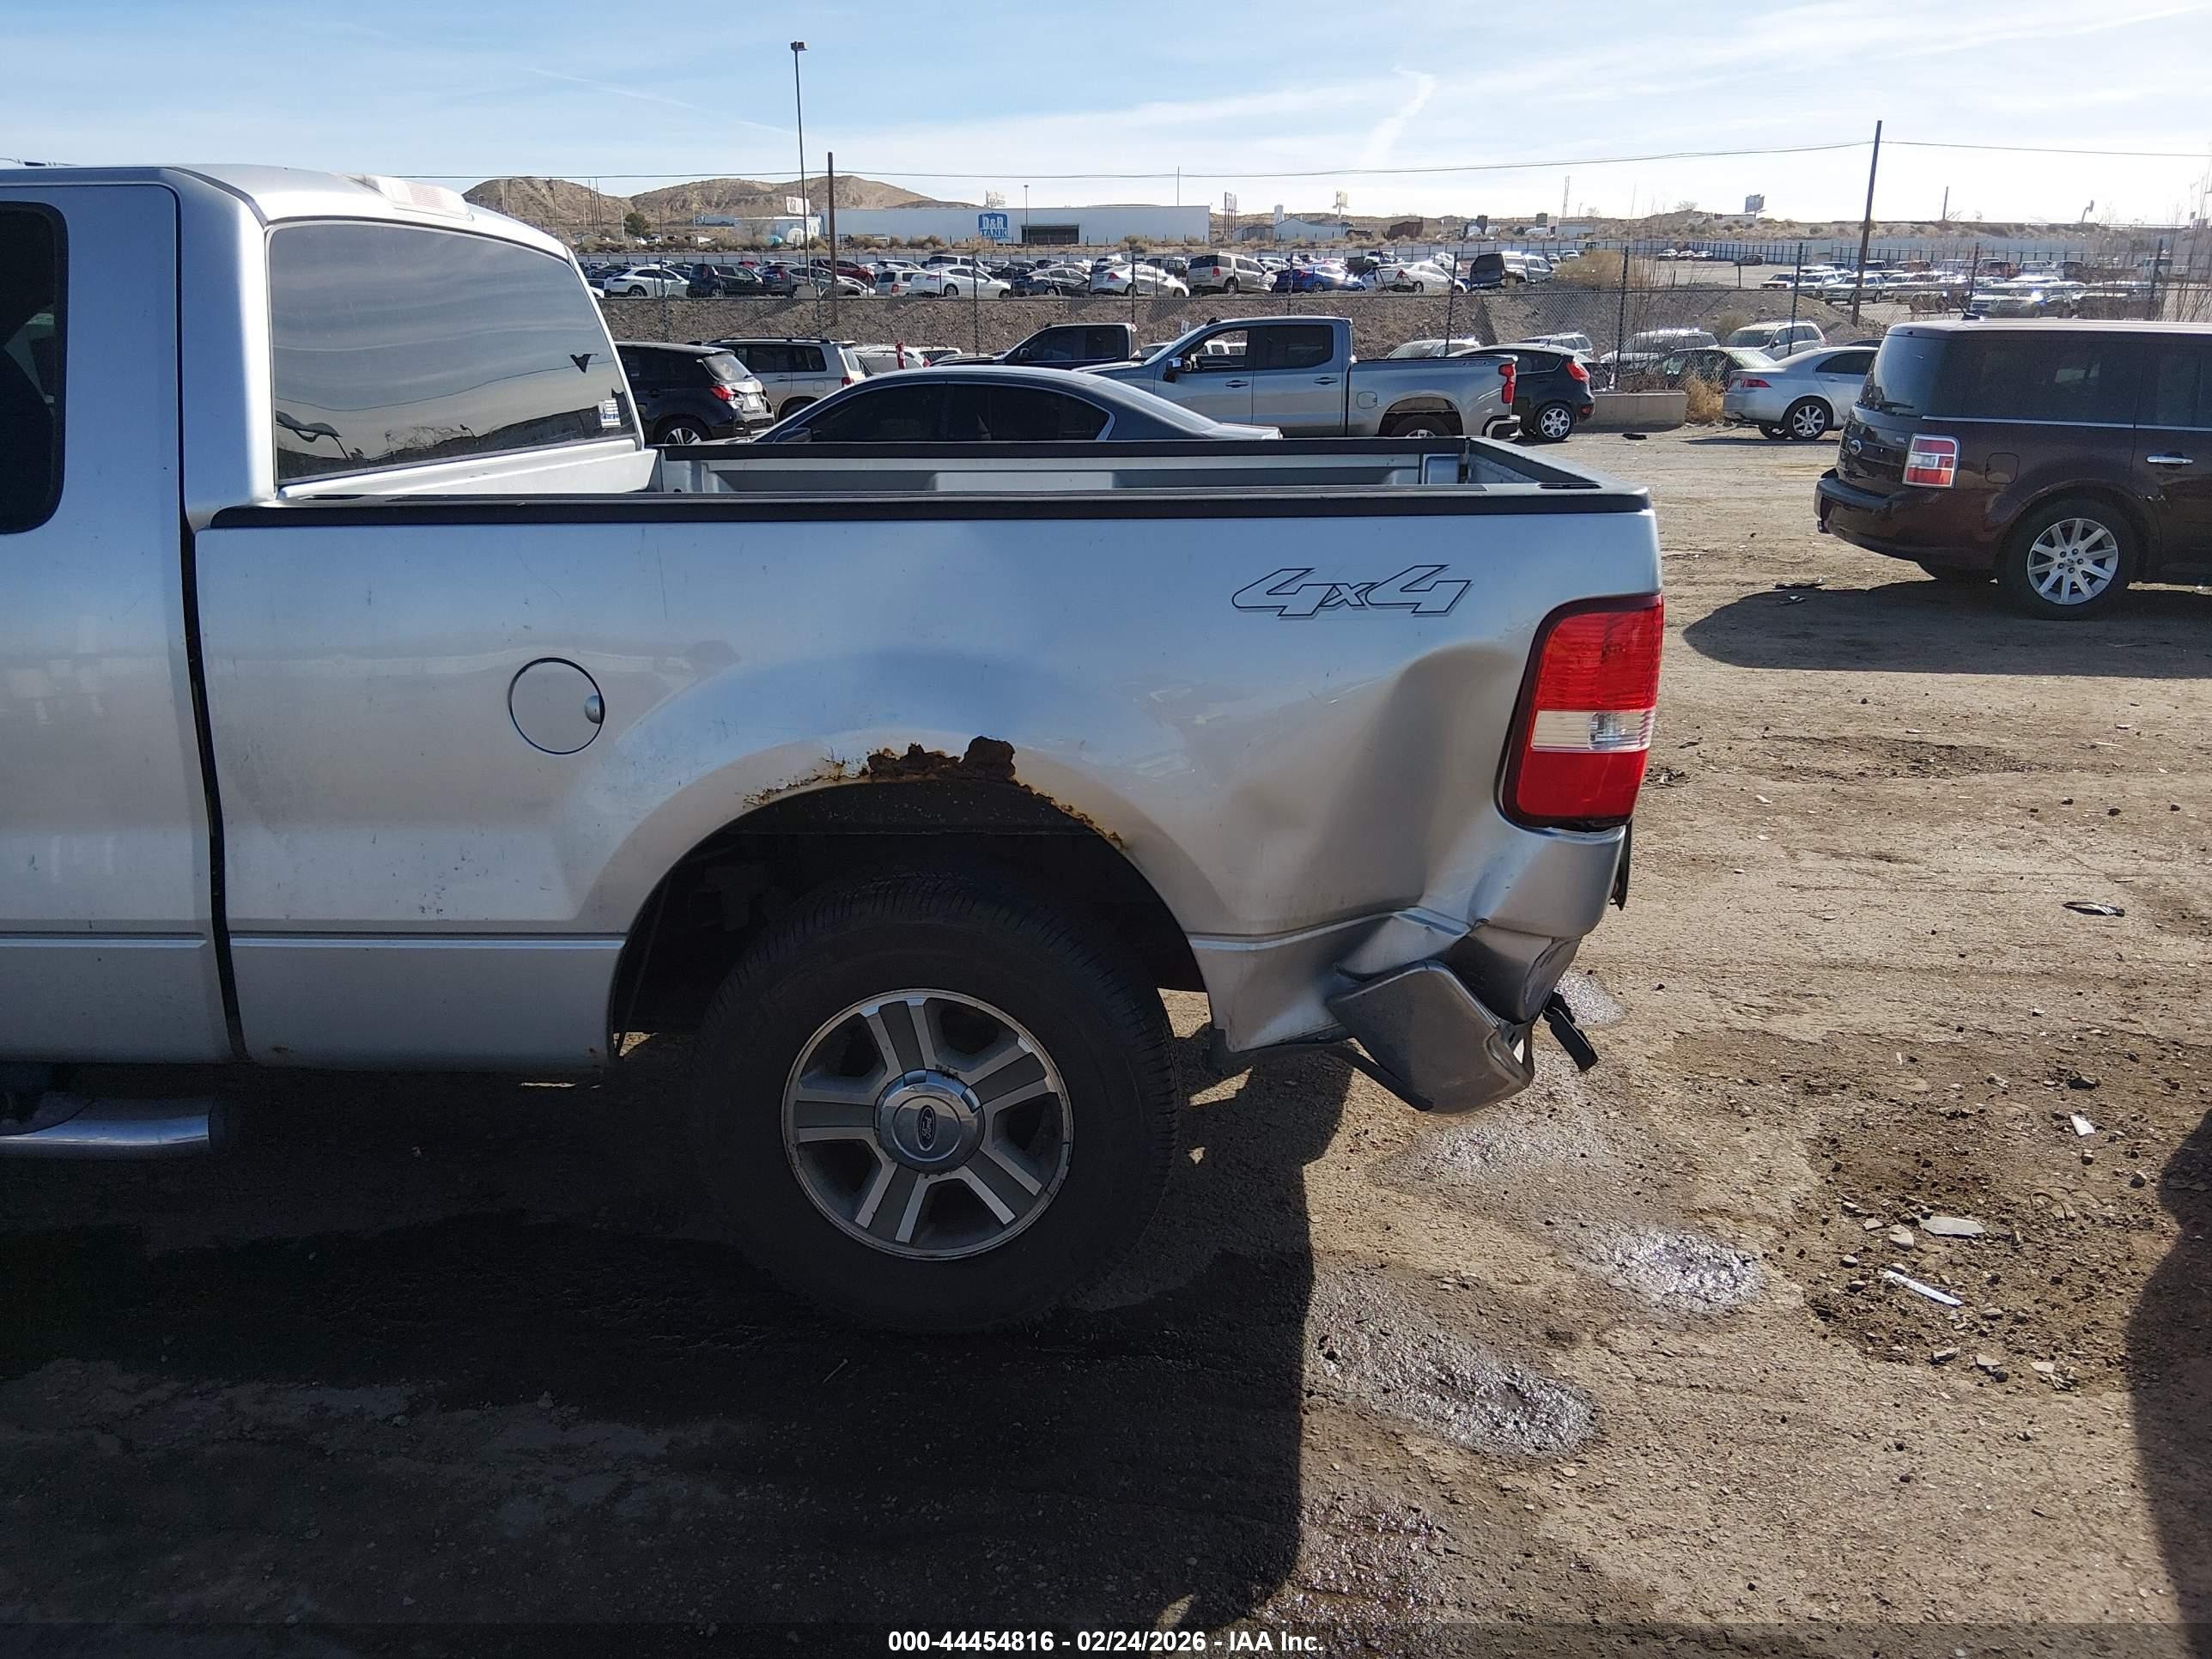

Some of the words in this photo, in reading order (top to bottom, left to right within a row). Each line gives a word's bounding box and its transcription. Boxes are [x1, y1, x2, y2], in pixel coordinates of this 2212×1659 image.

[980, 228, 1006, 237] TANK
[1231, 564, 1473, 618] 4x4
[921, 1115, 932, 1139] Ford
